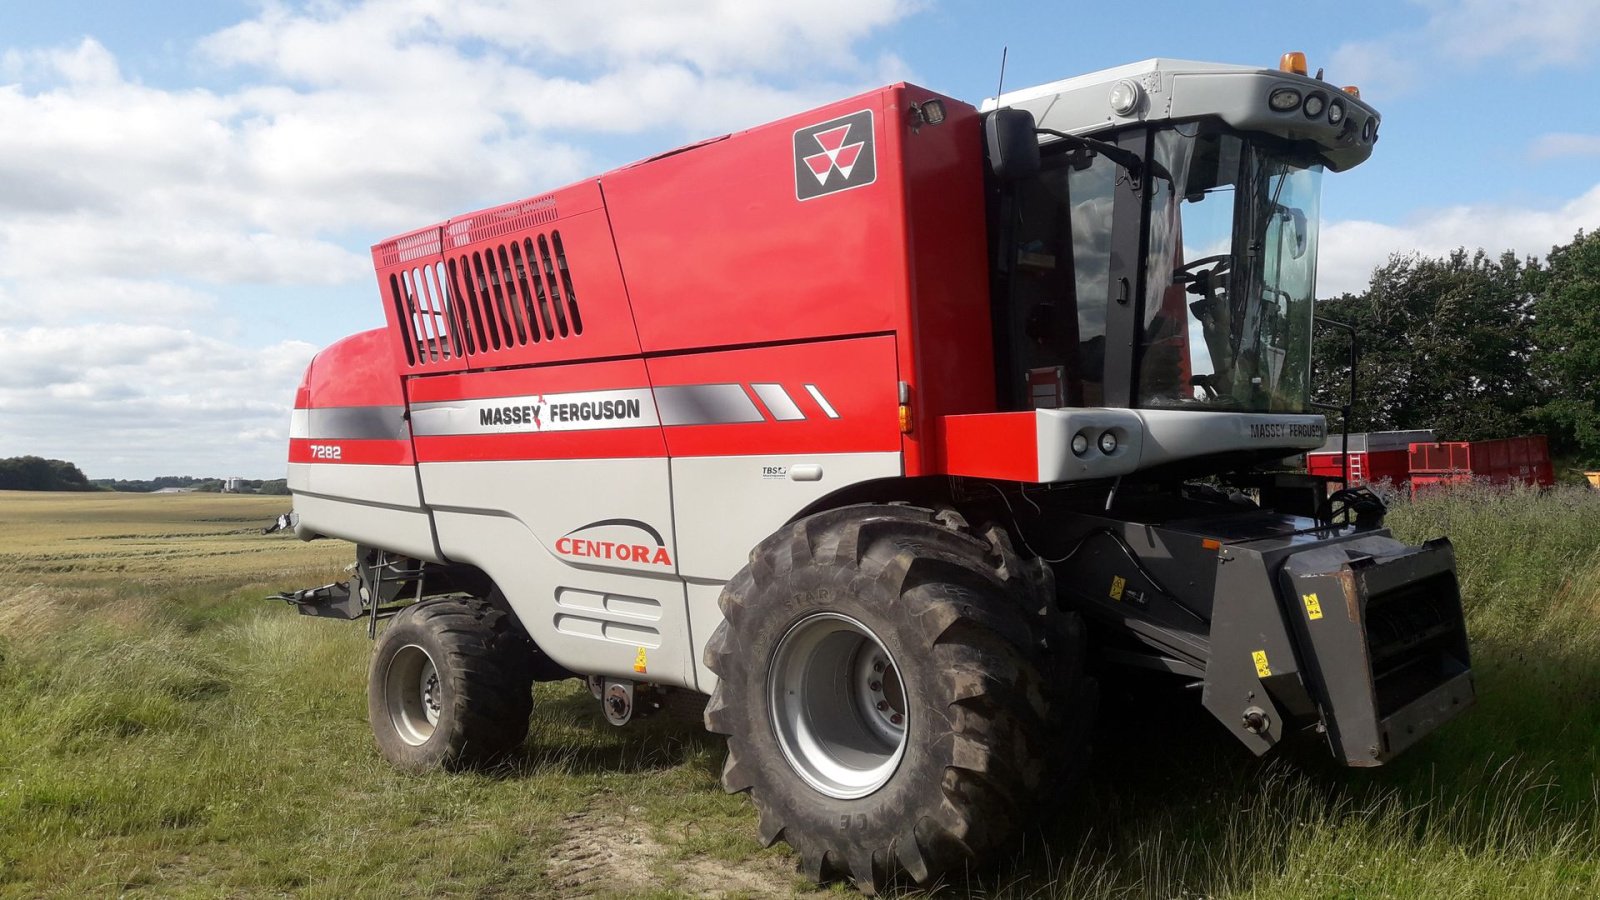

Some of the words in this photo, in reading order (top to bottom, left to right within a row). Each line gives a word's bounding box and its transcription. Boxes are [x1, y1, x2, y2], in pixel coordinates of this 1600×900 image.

[479, 405, 541, 426] MASSEY
[550, 399, 640, 422] FERGUSON
[1250, 424, 1286, 438] MASSEY
[310, 445, 342, 460] 7282
[763, 466, 778, 475] TBS
[555, 537, 672, 566] CENTORA
